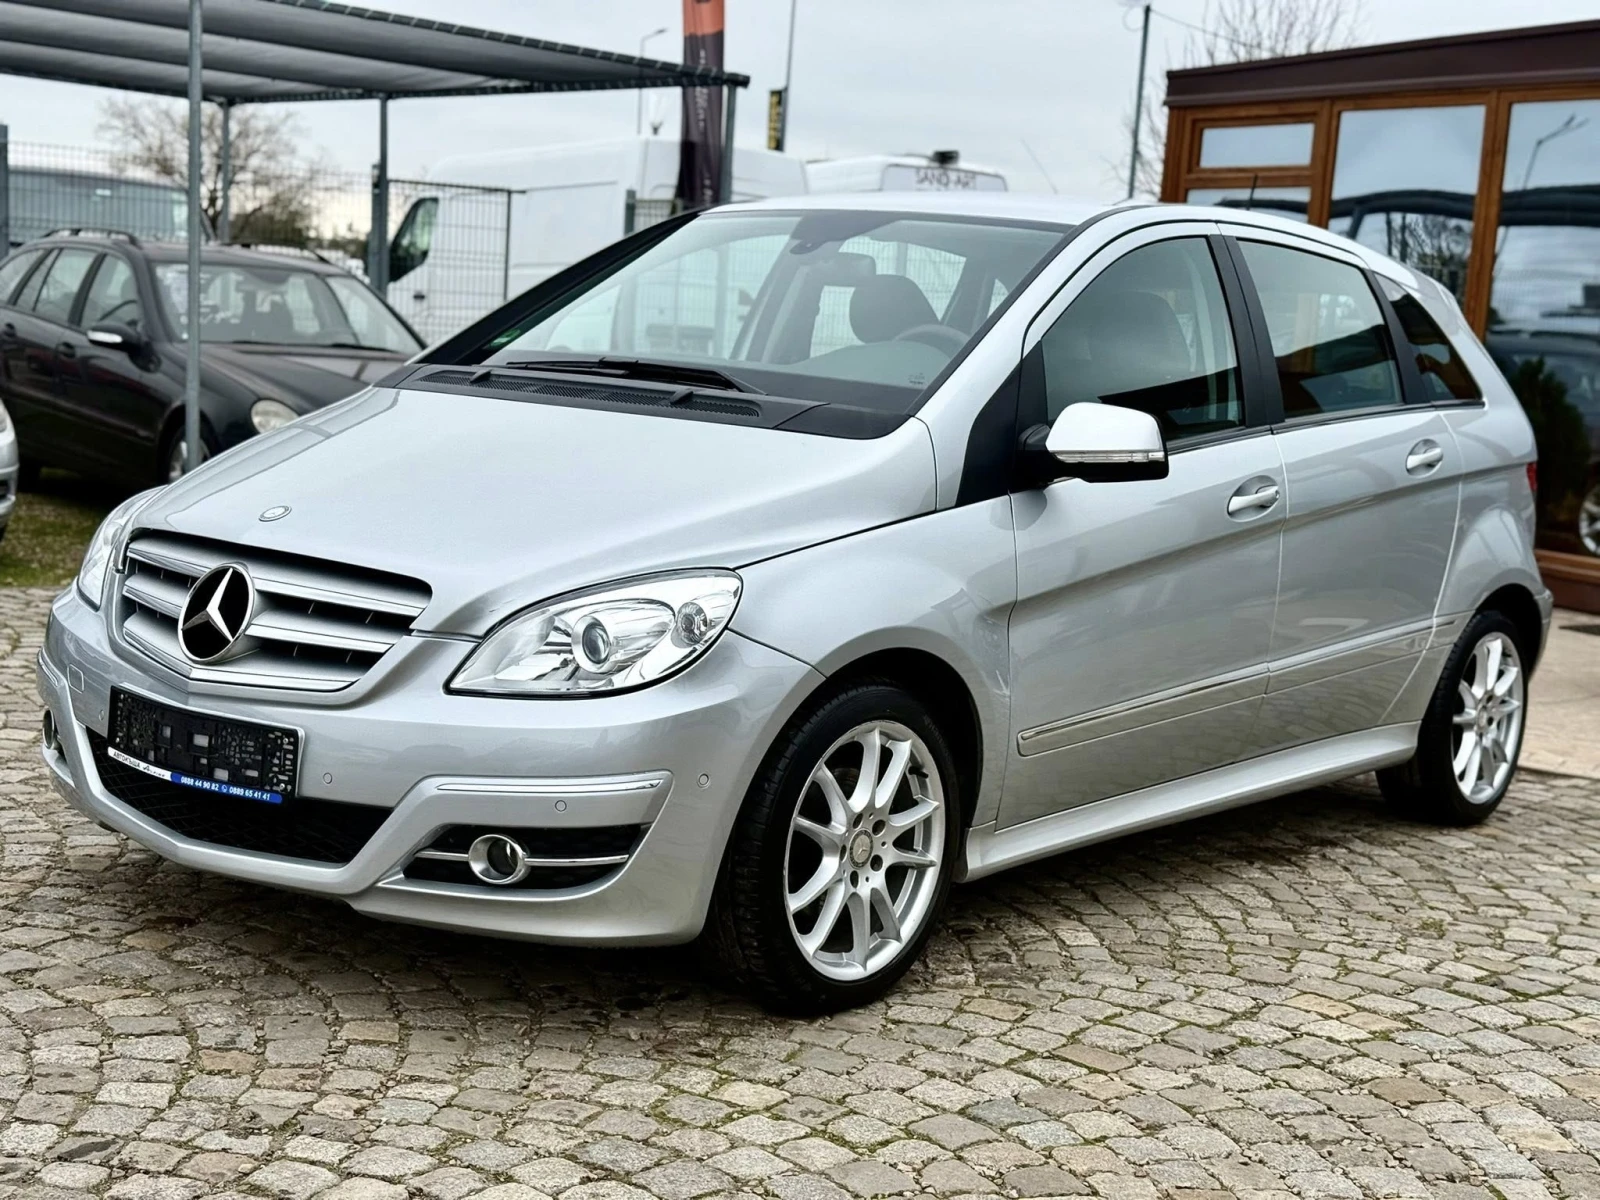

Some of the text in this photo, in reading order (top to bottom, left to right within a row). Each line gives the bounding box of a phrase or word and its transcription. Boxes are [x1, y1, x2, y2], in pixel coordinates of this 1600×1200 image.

[180, 776, 194, 786] 0888
[194, 779, 202, 787] 44
[202, 781, 211, 789] 90
[229, 786, 244, 796] 0889
[245, 789, 253, 797] 65
[253, 791, 261, 799] 41
[262, 793, 270, 801] 41
